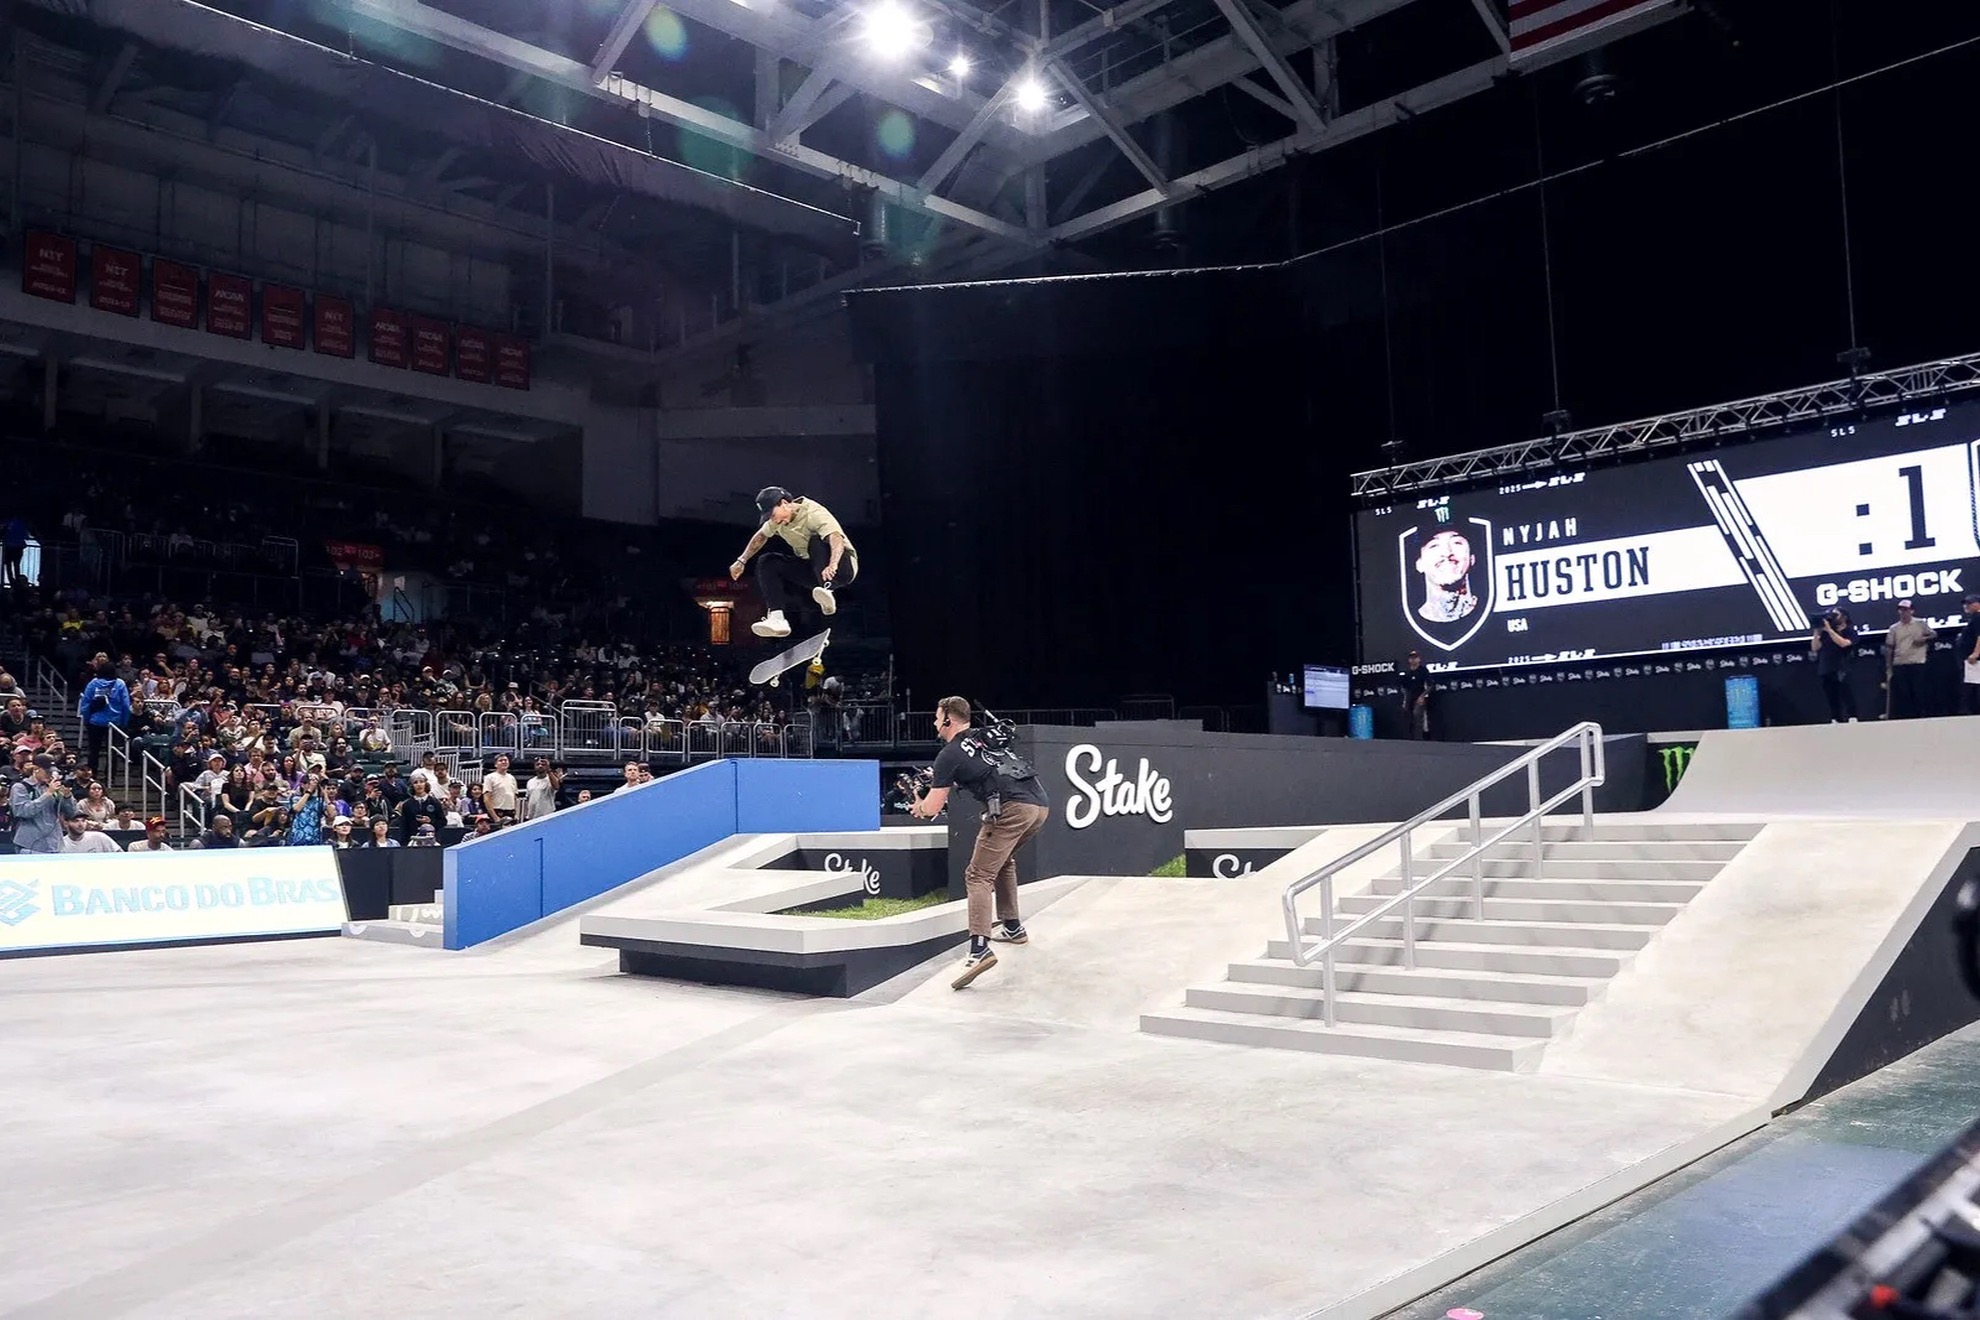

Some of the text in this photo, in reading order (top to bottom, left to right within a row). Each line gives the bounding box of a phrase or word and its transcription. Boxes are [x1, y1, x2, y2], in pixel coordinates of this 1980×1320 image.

[1831, 425, 1855, 438] SLS
[1499, 483, 1521, 495] 2025
[1375, 506, 1392, 516] SLS
[1502, 517, 1577, 546] NYJAH
[1505, 546, 1650, 601] HUSTON
[1816, 568, 1964, 607] G-SHOCK
[1507, 618, 1528, 633] USA
[1351, 662, 1395, 675] G-SHOCK
[1065, 743, 1173, 829] Stake
[824, 852, 881, 895] Stke
[51, 883, 190, 917] BANCO
[194, 882, 245, 910] DO
